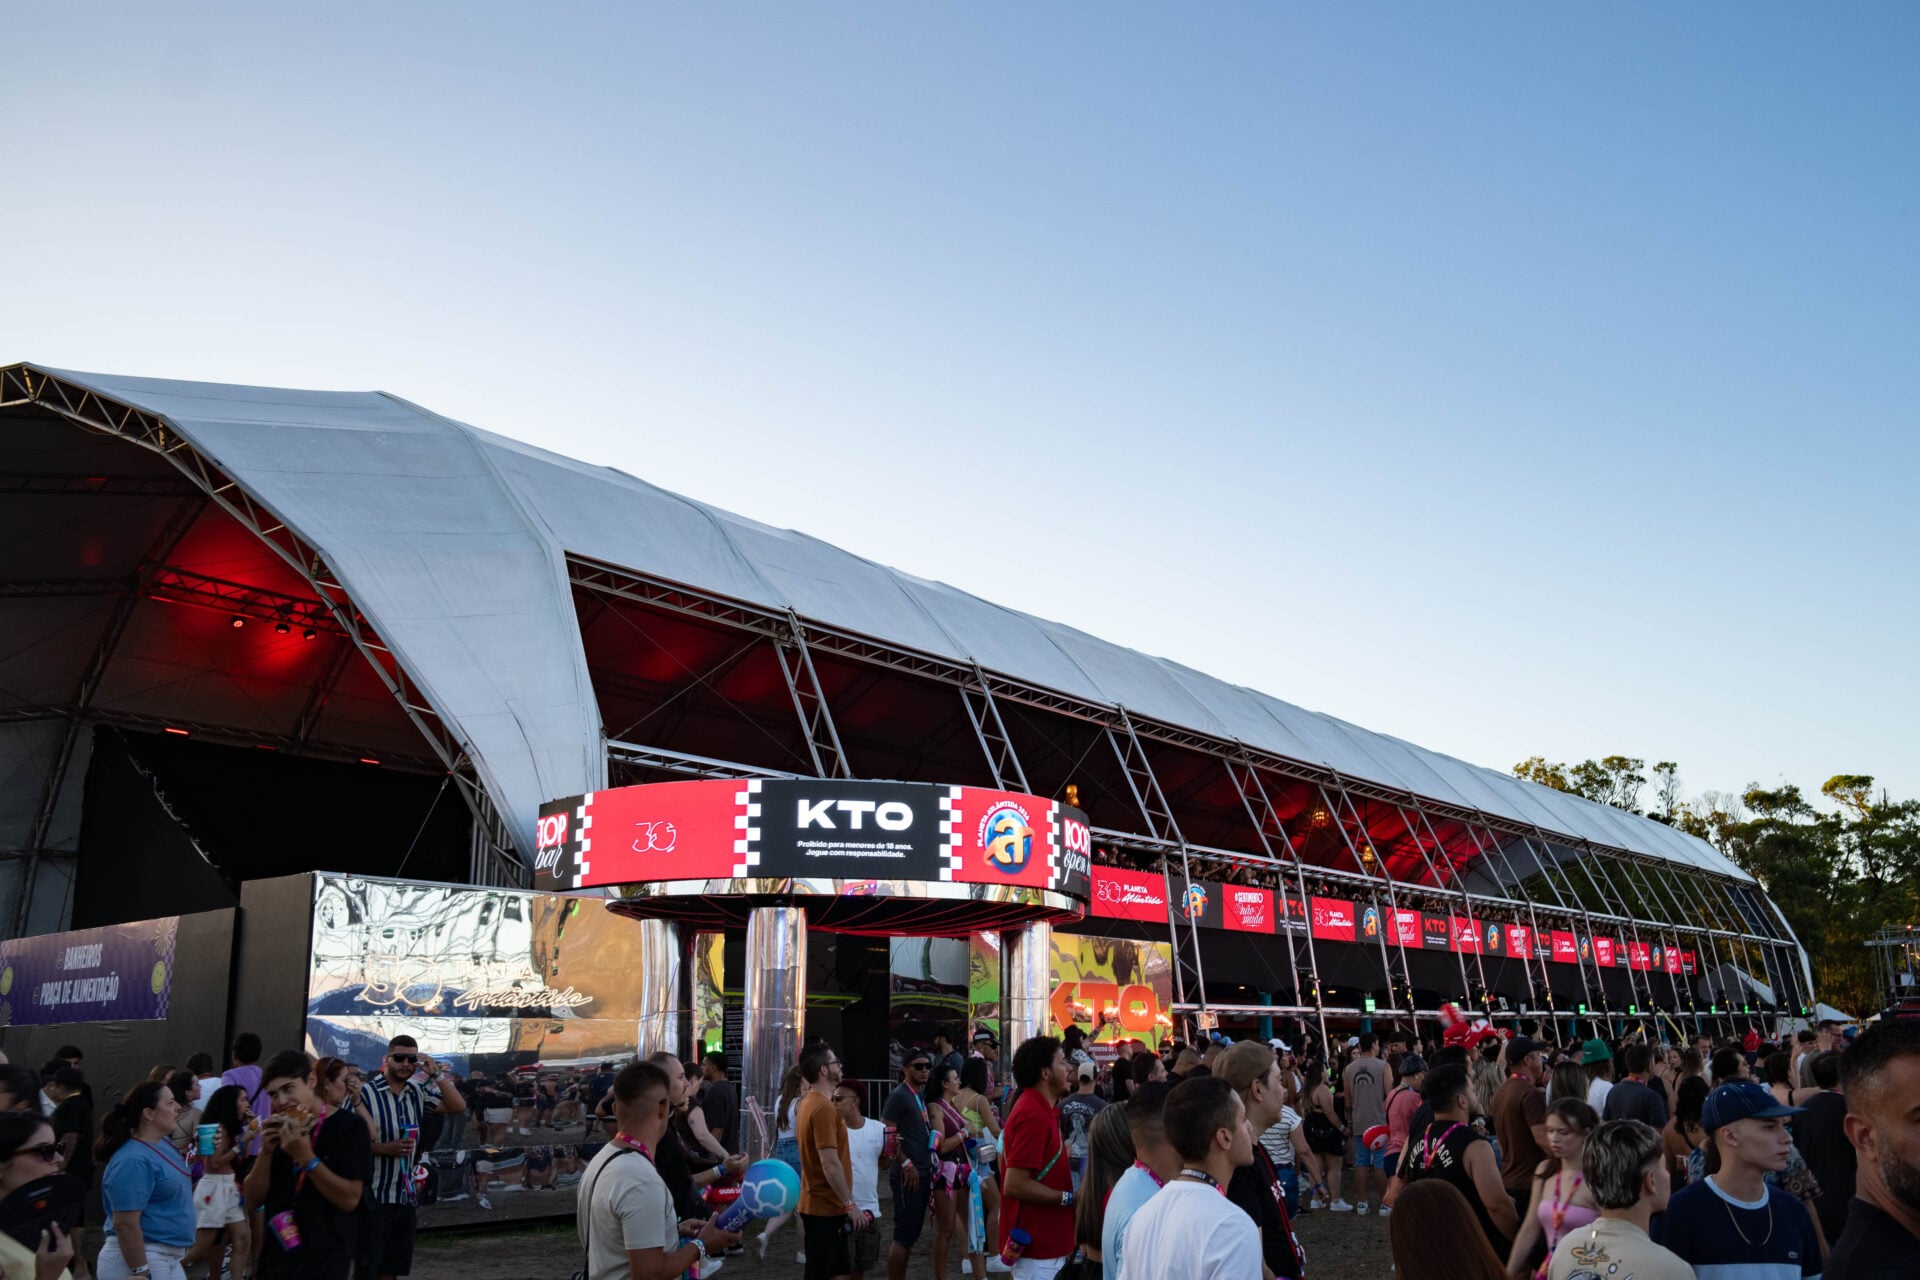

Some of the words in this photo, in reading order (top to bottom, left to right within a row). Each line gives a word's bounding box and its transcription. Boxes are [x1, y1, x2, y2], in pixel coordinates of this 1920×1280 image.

[797, 799, 914, 831] KTO
[797, 840, 828, 849] Proibido
[828, 841, 845, 849] para
[845, 842, 876, 850] menores
[805, 849, 828, 857] Jogue
[846, 850, 906, 858] responsabilidade.
[1424, 918, 1446, 933] KTO
[64, 943, 103, 970] BANHEIROS
[40, 982, 61, 1009] PRAÇA
[61, 980, 72, 1004] DE
[71, 971, 119, 1007] ALIMENTAÇÃO
[1409, 1139, 1425, 1168] VENIC
